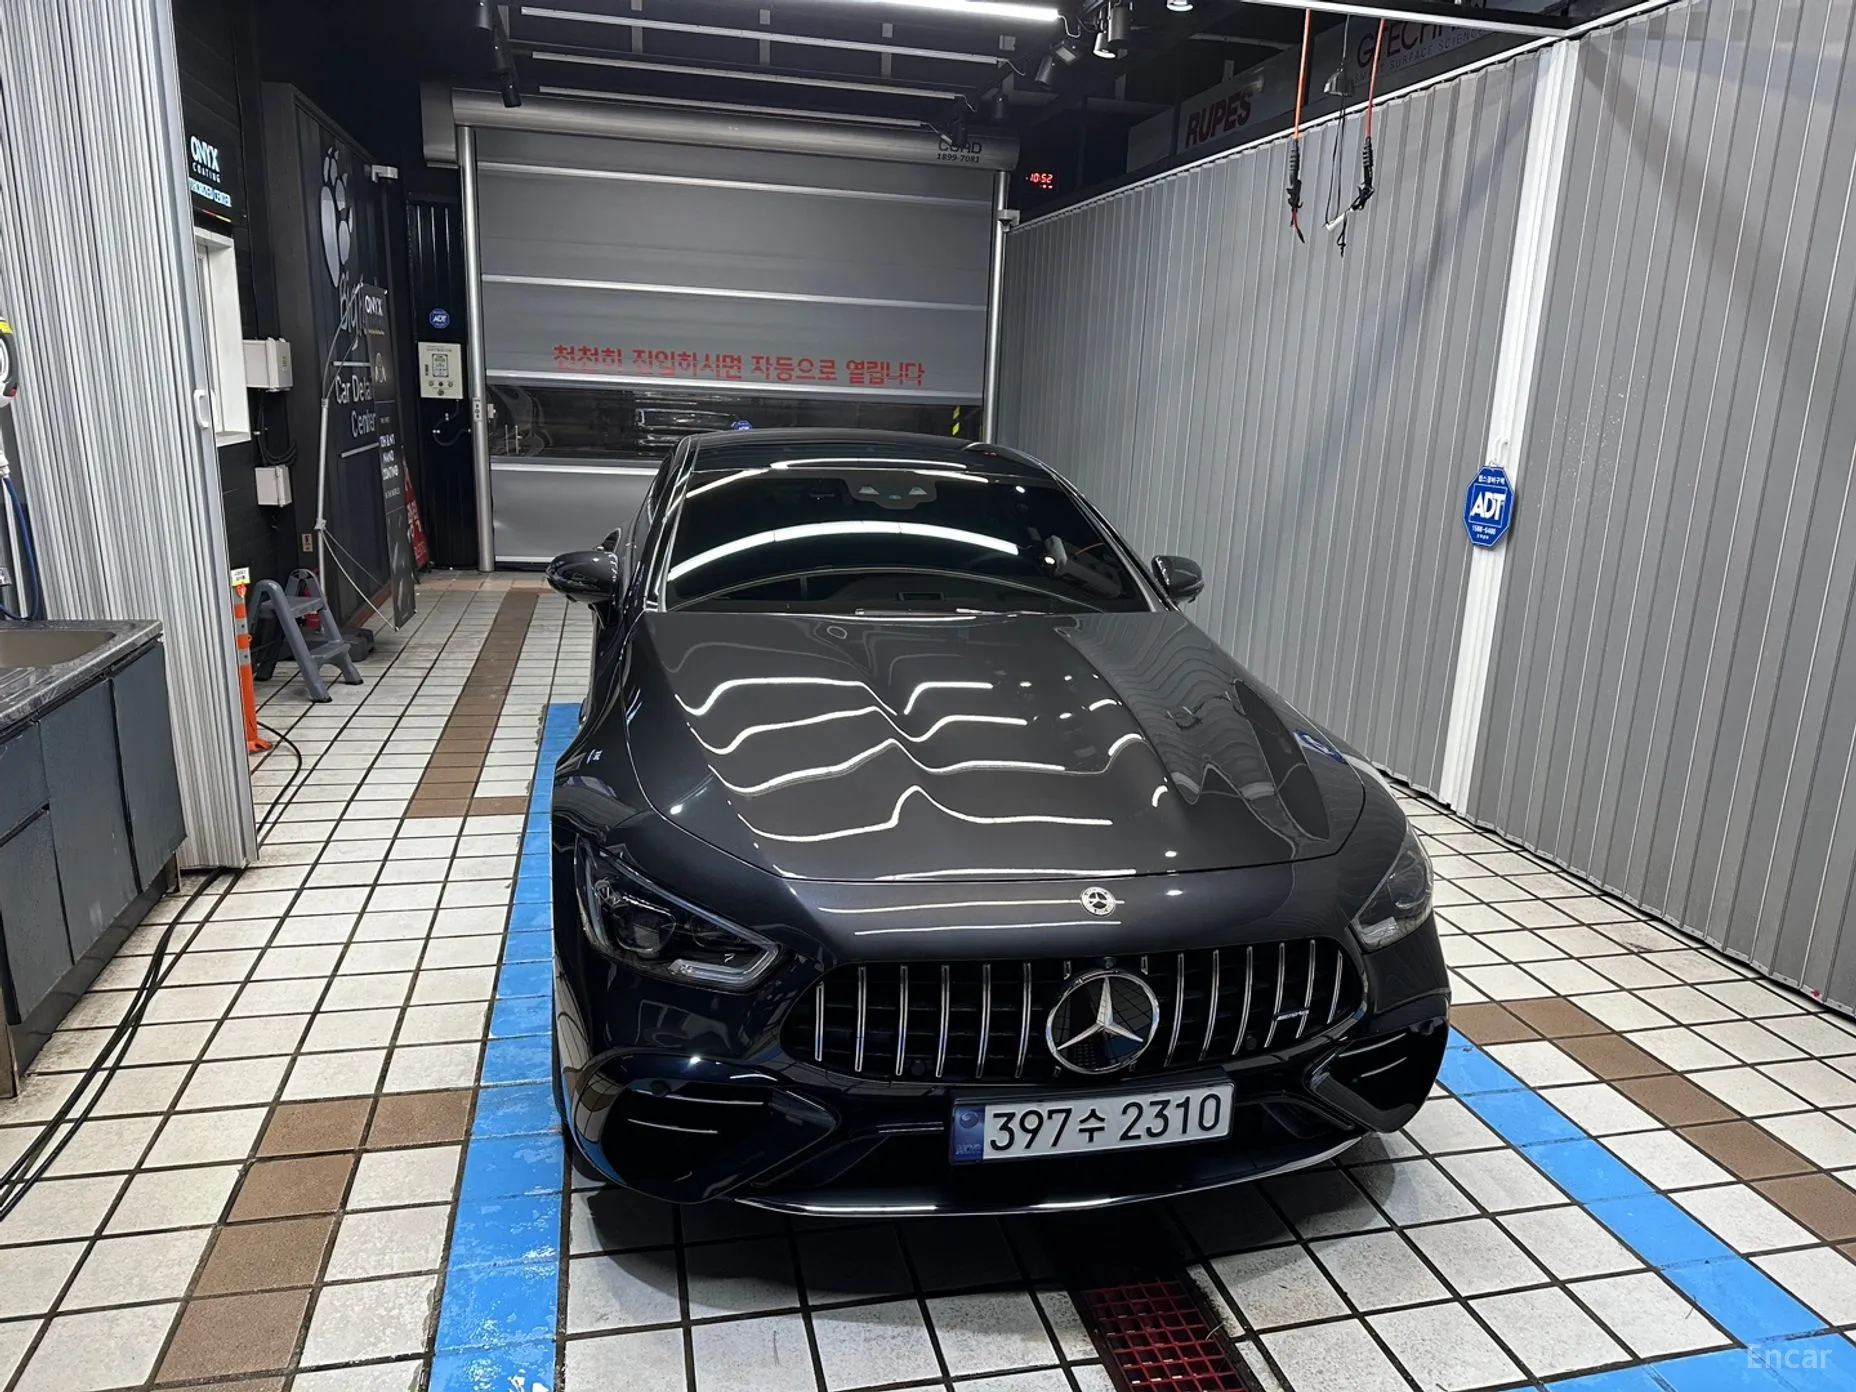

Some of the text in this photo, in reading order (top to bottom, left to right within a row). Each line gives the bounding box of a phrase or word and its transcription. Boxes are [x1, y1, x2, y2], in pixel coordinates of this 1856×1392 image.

[1390, 46, 1433, 70] SURFACE
[1186, 87, 1254, 148] RUPES
[190, 135, 220, 172] ONYX
[364, 294, 384, 317] ONYX
[553, 344, 926, 387] 천천히 진입하시면 자동으로 열립니다
[335, 375, 350, 404] Car
[351, 409, 377, 438] Center
[1470, 491, 1506, 520] ADT
[989, 1093, 1223, 1152] 397수 2310
